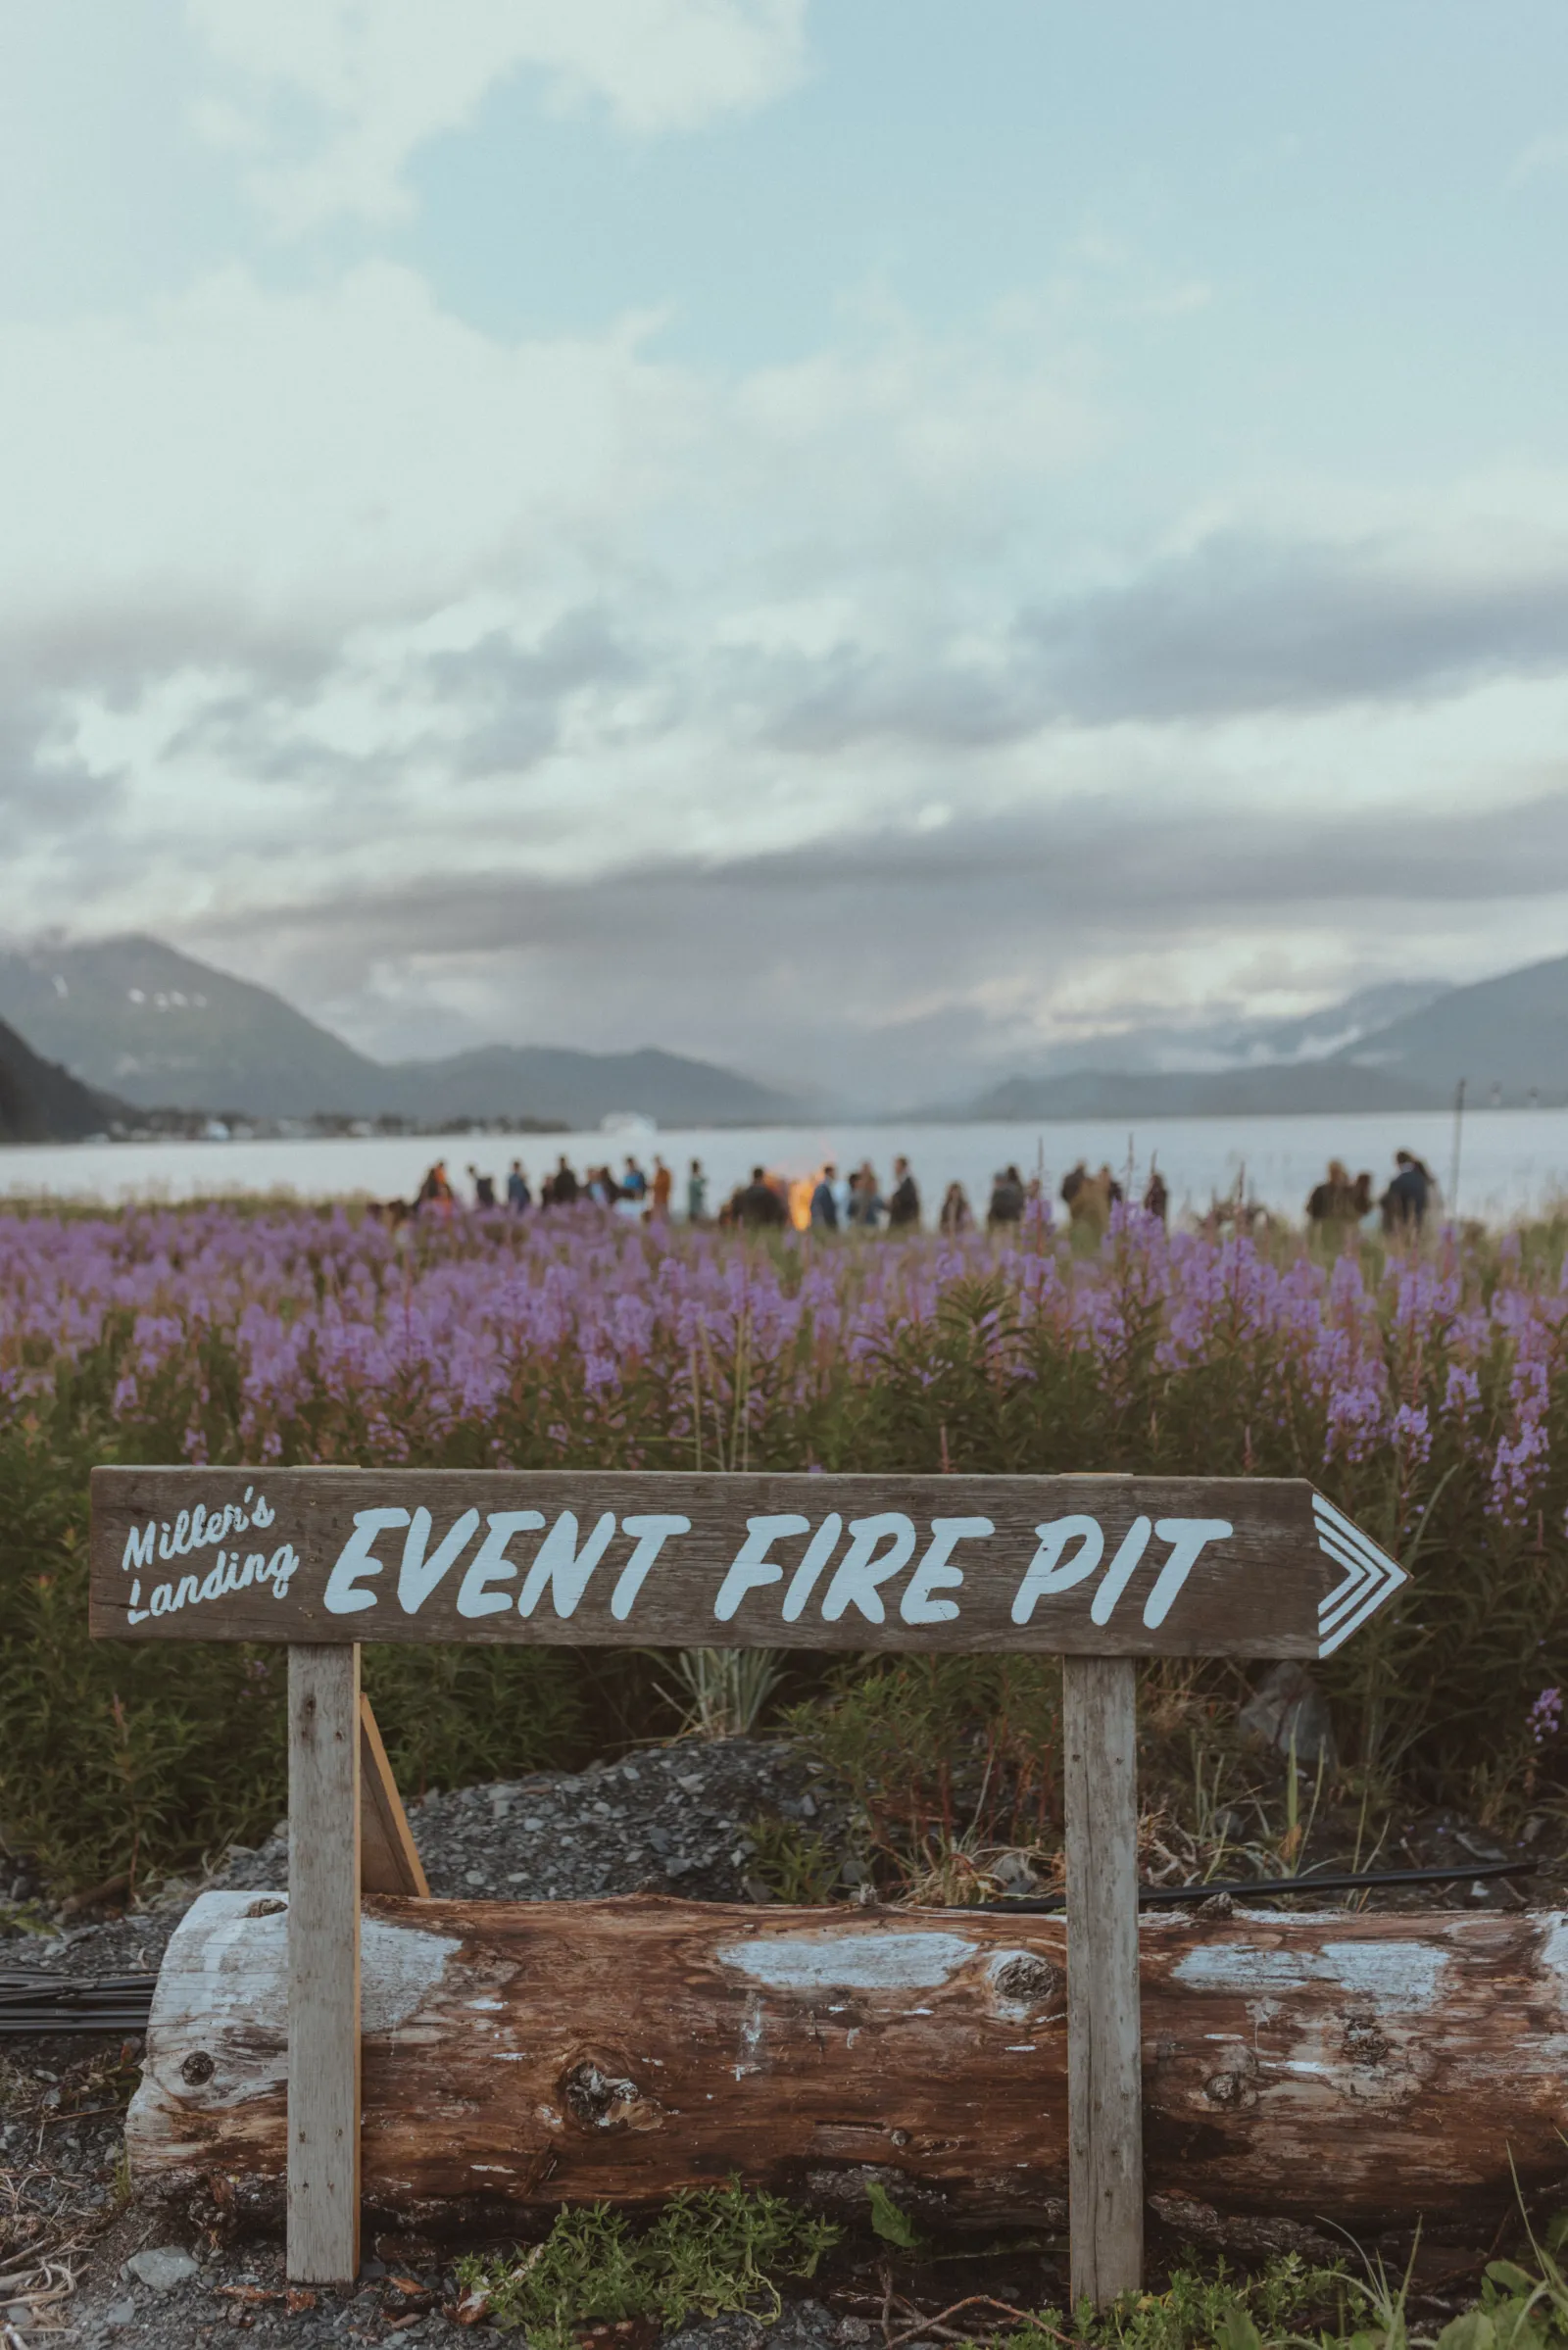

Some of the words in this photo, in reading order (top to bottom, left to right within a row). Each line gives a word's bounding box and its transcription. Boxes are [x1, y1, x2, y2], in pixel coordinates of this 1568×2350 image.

[122, 1486, 275, 1571] Miller's
[323, 1506, 691, 1621] EVENT
[714, 1512, 996, 1624] FIRE
[1011, 1514, 1233, 1629] PIT
[127, 1543, 300, 1625] Landing
